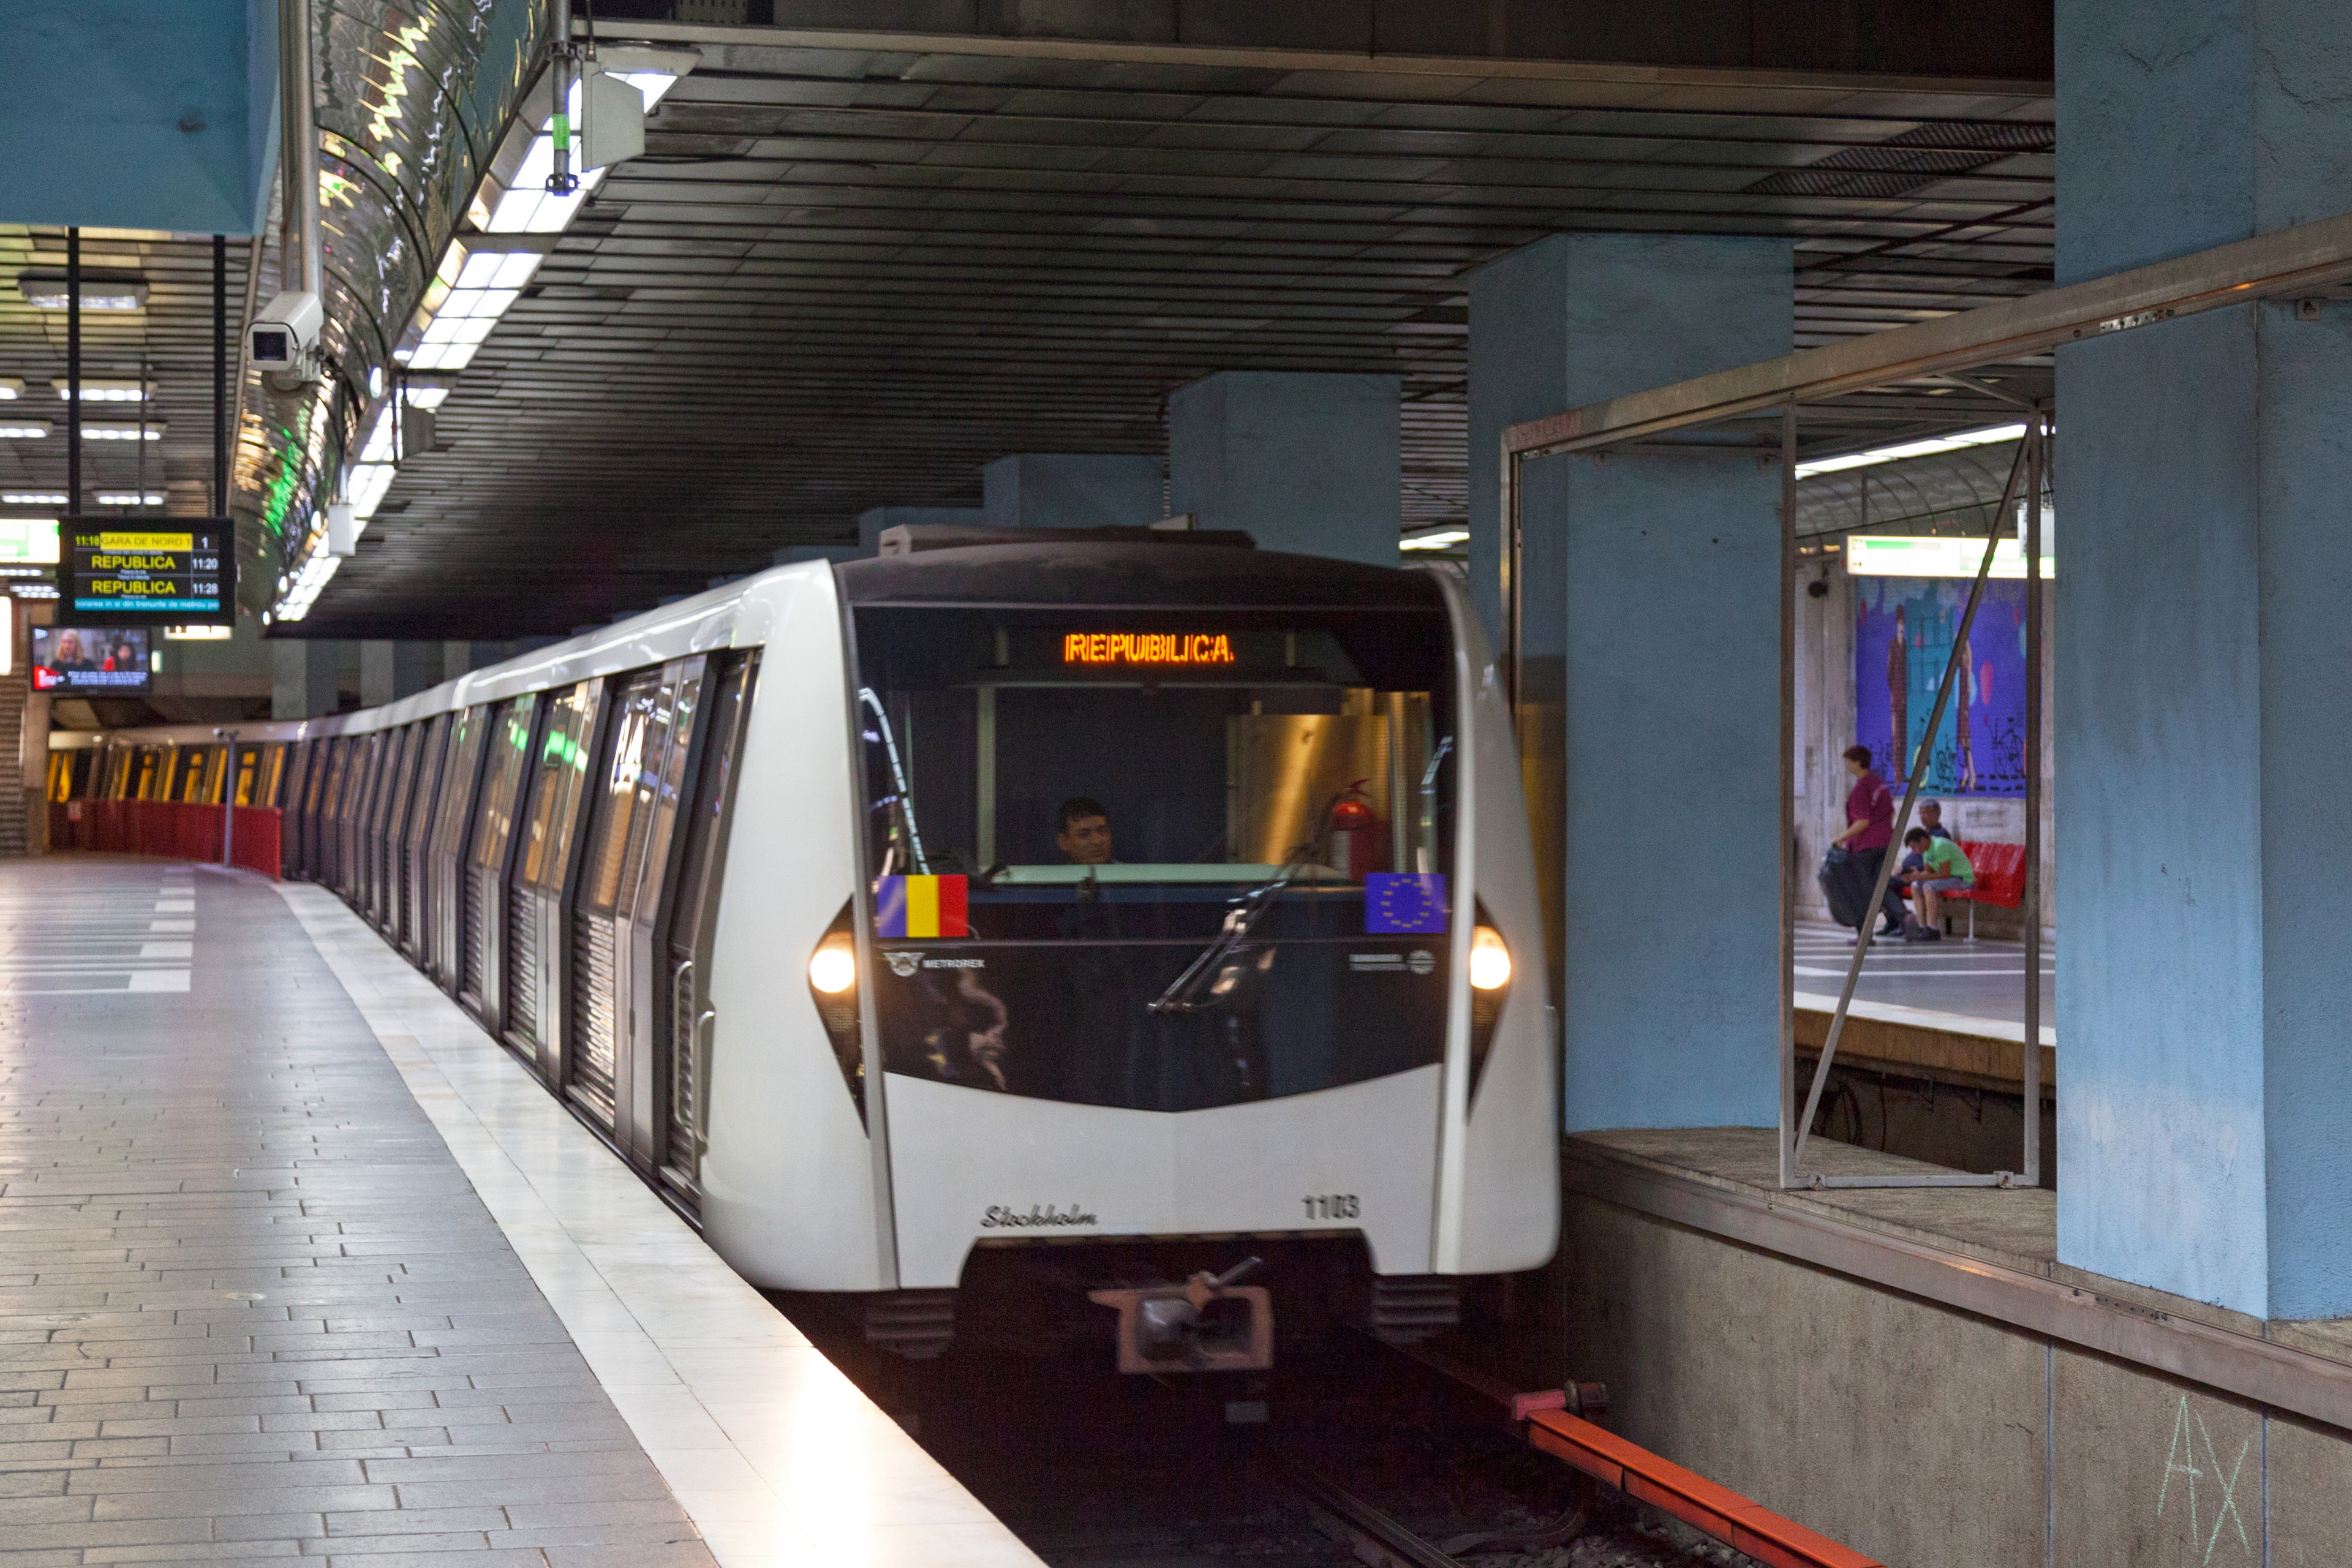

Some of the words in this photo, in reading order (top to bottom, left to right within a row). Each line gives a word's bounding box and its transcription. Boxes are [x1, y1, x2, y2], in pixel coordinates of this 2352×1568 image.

[101, 536, 131, 545] GARA
[134, 536, 148, 545] DE
[202, 536, 208, 549] 1
[92, 555, 176, 568] REPUBLICA
[193, 558, 219, 570] 11:20
[92, 580, 176, 594] REPUBLICA
[1065, 633, 1234, 662] REPUBLICA
[981, 1202, 1099, 1227] Stockholm
